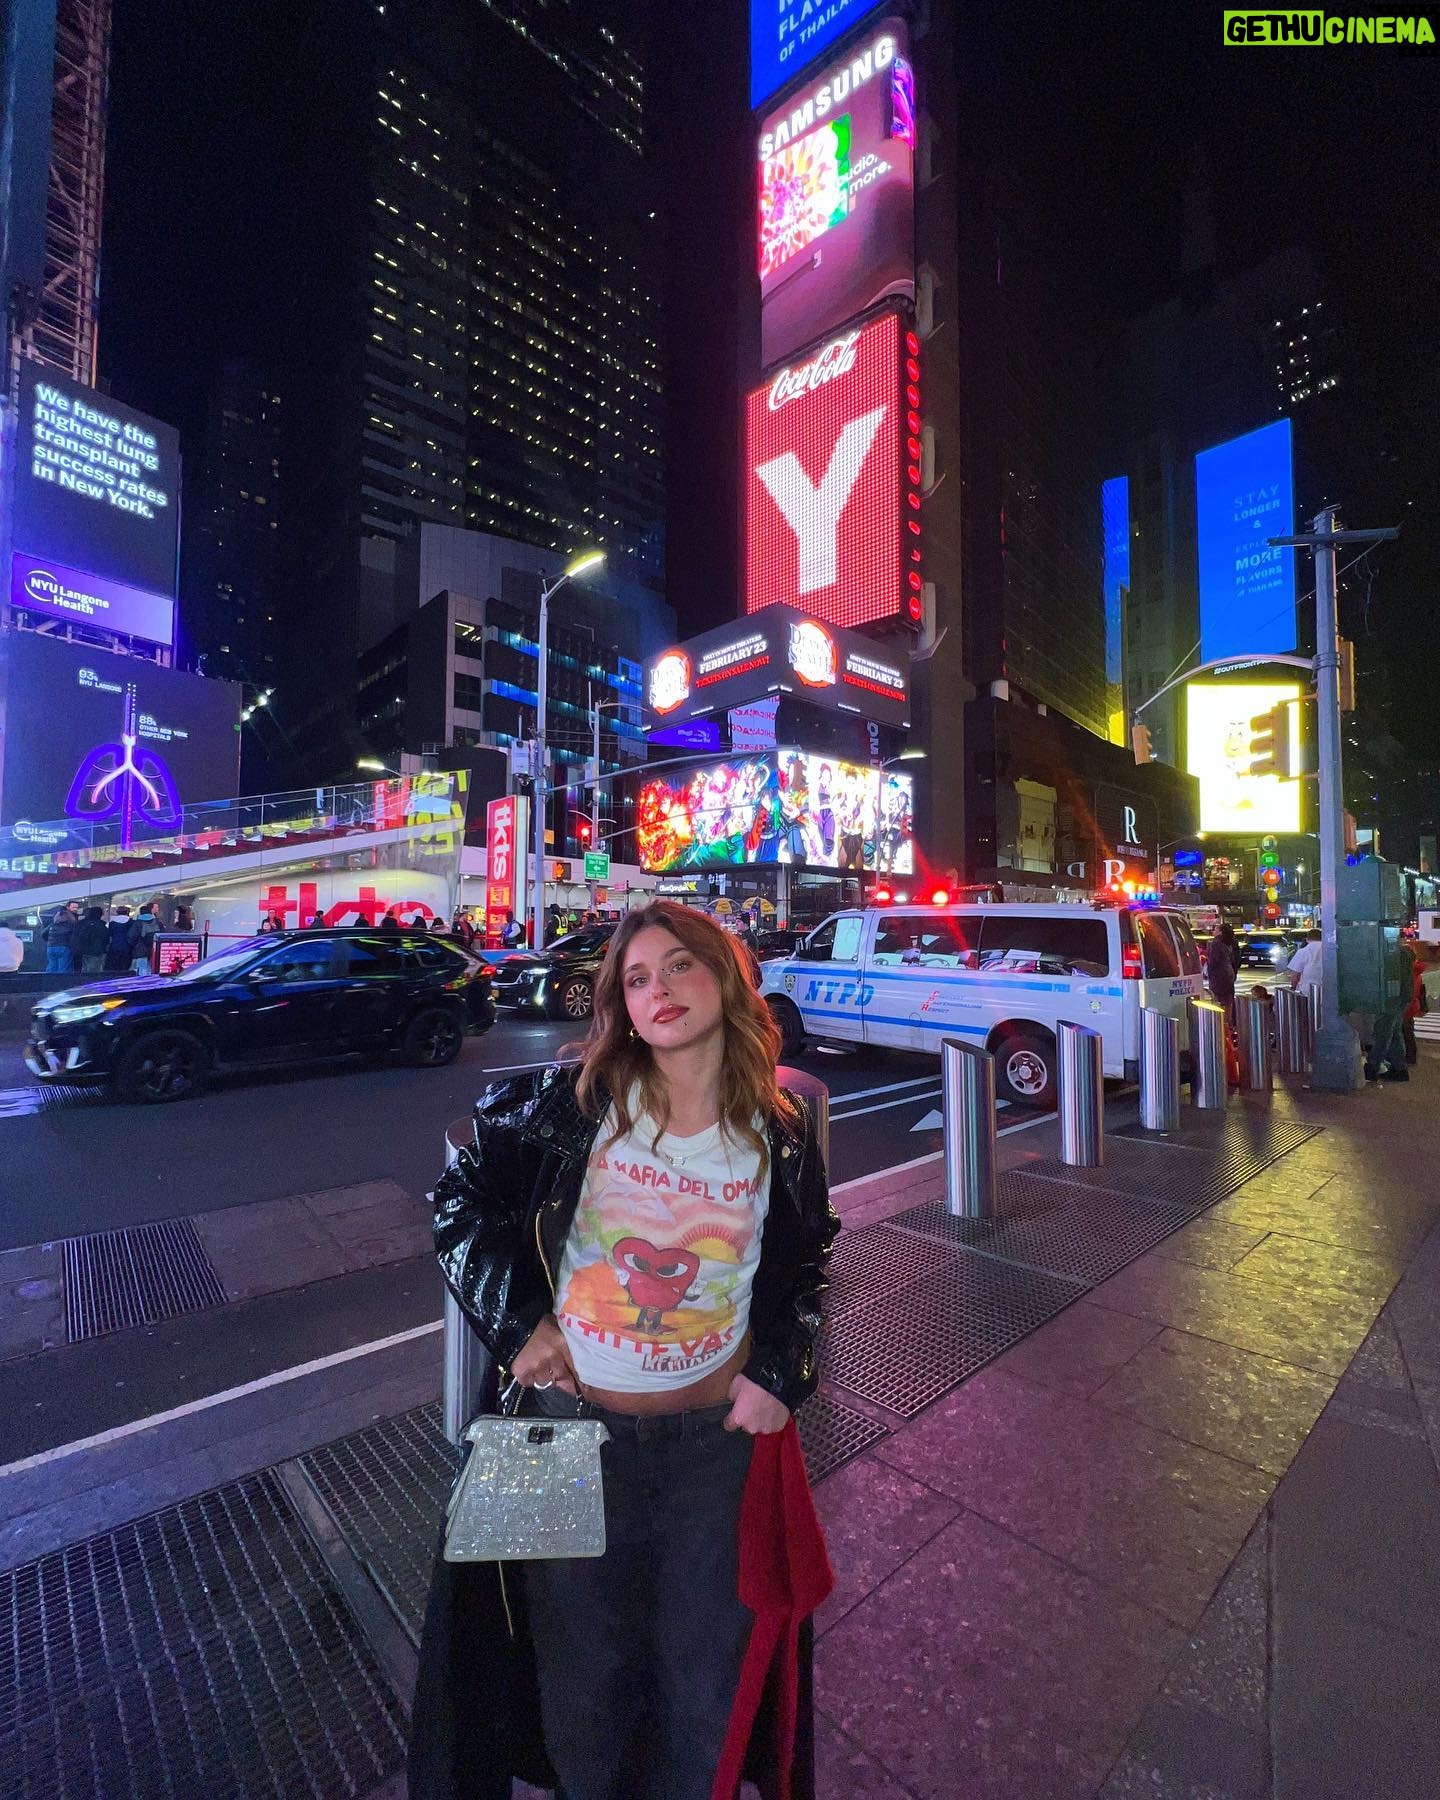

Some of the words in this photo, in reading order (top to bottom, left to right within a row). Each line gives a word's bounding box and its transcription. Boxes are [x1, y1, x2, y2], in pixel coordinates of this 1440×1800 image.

[779, 39, 796, 62] OF
[760, 36, 893, 161] SAMSUNG
[850, 161, 892, 195] more.
[35, 383, 69, 411] We
[73, 401, 120, 433] have
[123, 422, 157, 449] the
[35, 423, 140, 477] transplant
[36, 403, 113, 448] highest
[116, 438, 159, 471] lung
[34, 460, 55, 481] in
[60, 469, 103, 500] New
[107, 487, 154, 519] York.
[35, 445, 115, 486] success
[120, 478, 168, 506] rates
[756, 405, 887, 594] Y
[1234, 483, 1280, 508] STAY
[1234, 499, 1280, 522] LONGER
[1253, 520, 1262, 528] &
[1236, 547, 1283, 571] MORE
[30, 577, 58, 594] NYU
[59, 586, 110, 609] Langone
[53, 595, 94, 615] Health
[700, 645, 753, 674] FEBRUARY
[753, 640, 767, 655] 23
[846, 659, 893, 685] FEBRUARY
[892, 677, 904, 689] 23
[492, 803, 512, 881] tkts
[1124, 806, 1141, 844] R
[804, 980, 875, 1006] NYPD
[678, 1175, 715, 1201] DEL
